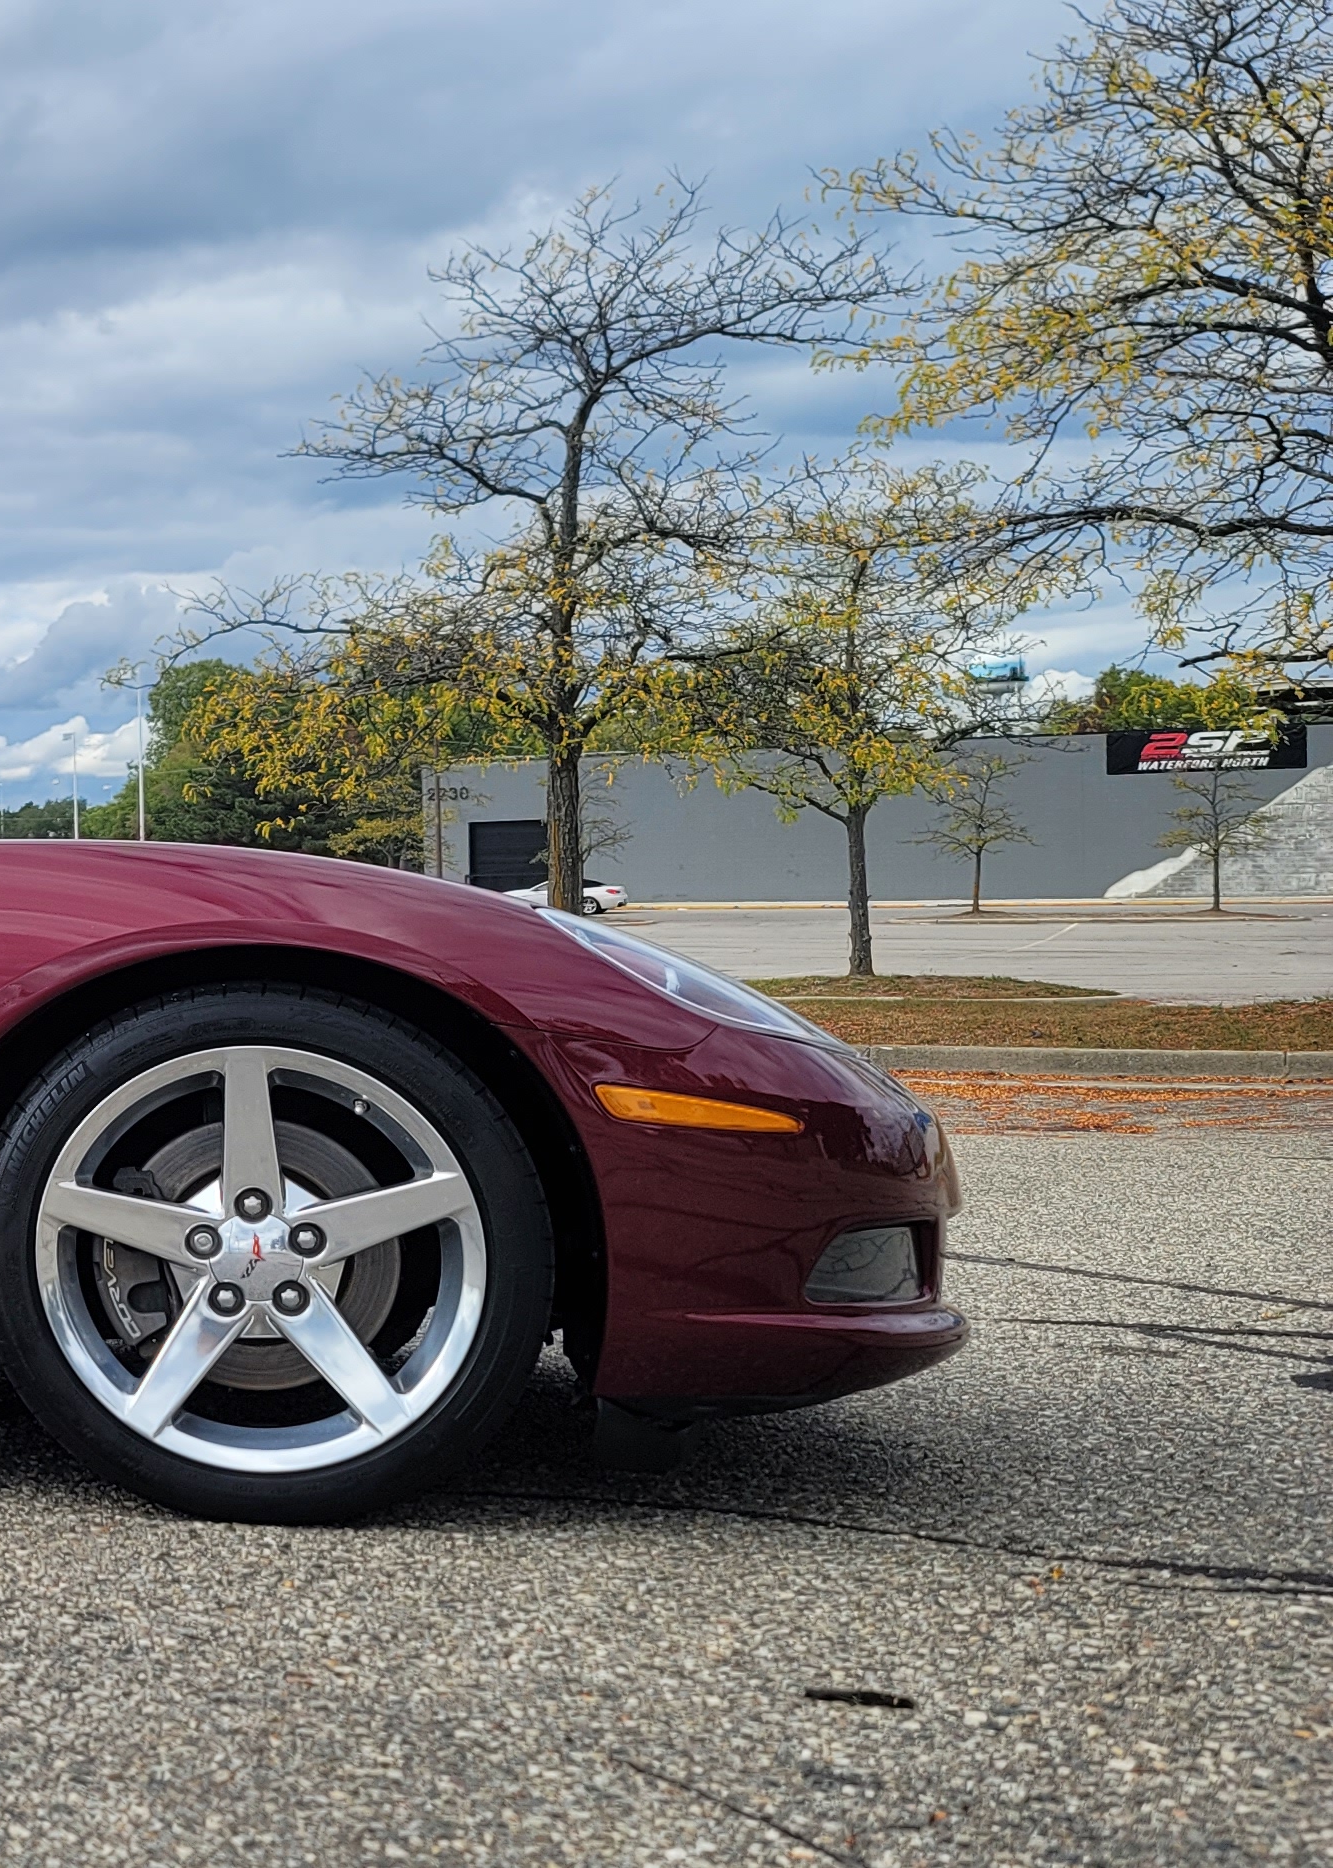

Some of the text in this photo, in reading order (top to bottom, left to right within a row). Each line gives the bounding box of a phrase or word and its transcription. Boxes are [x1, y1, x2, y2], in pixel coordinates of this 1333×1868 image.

[1140, 731, 1270, 755] 2SP
[1137, 757, 1270, 771] WATERFORD NORTH
[6, 1063, 86, 1176] MICHELIN
